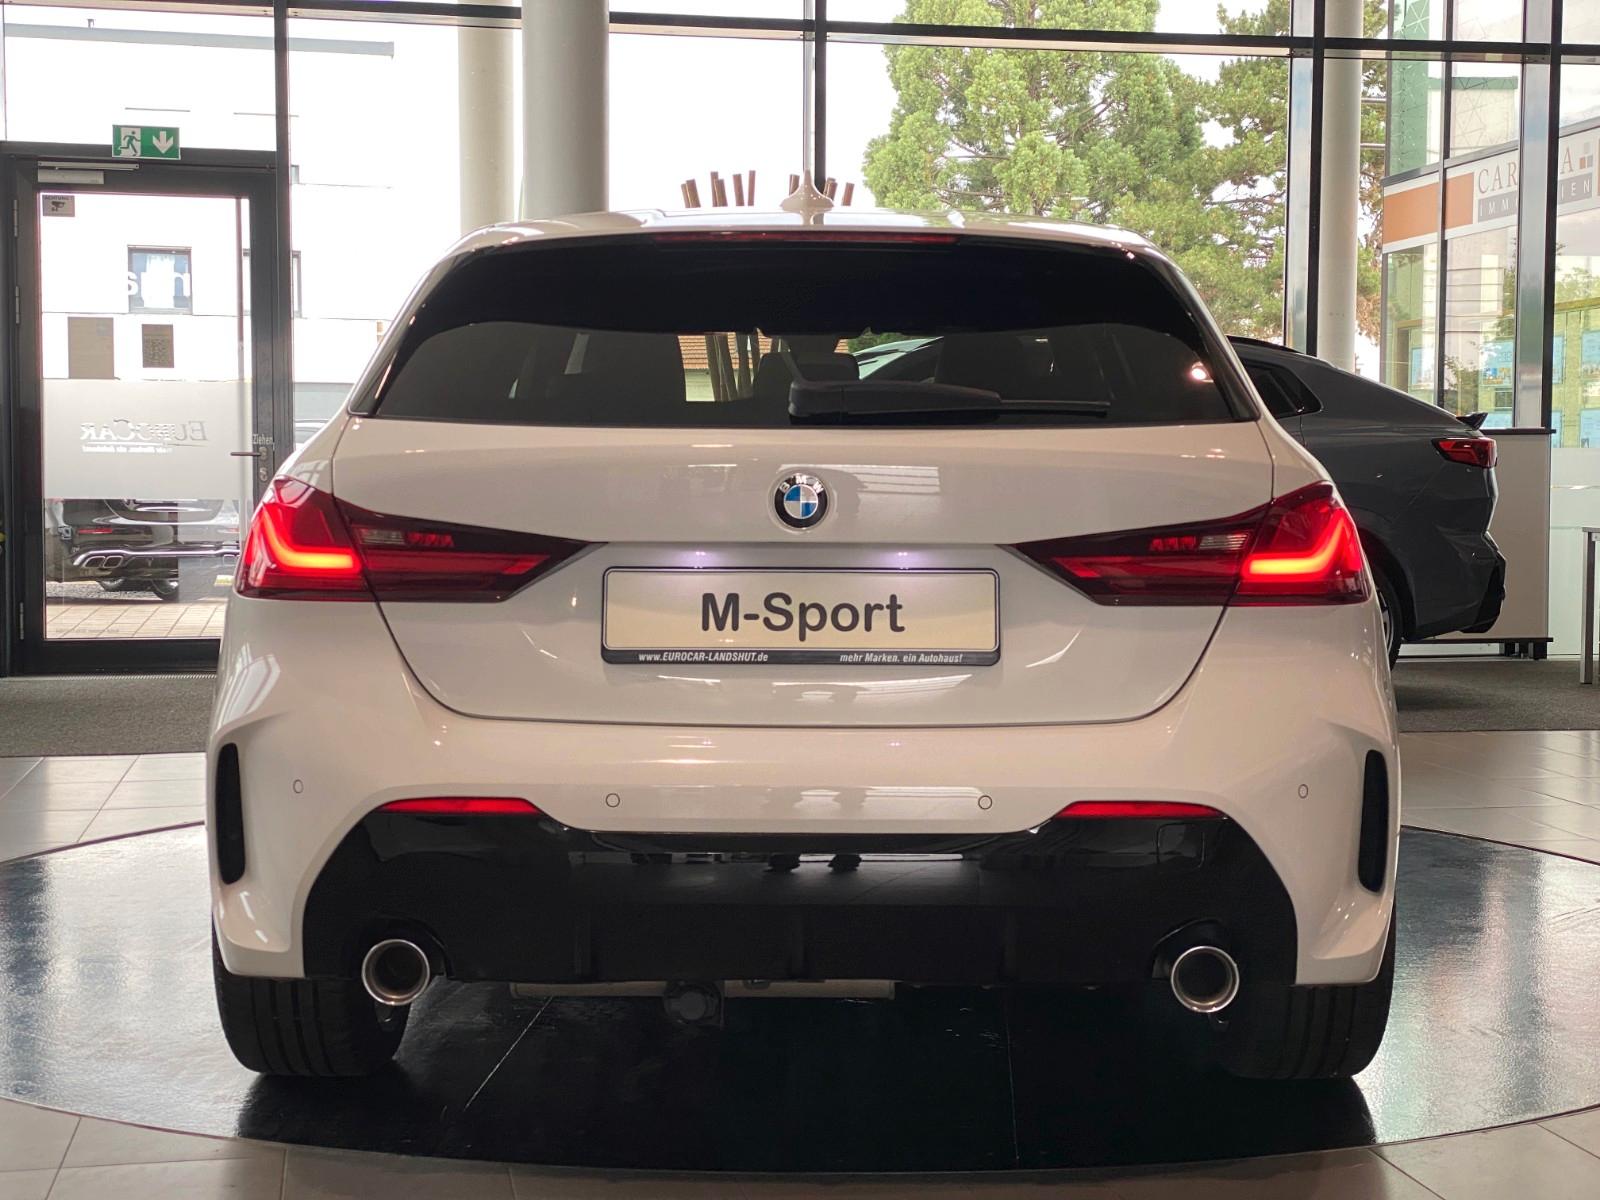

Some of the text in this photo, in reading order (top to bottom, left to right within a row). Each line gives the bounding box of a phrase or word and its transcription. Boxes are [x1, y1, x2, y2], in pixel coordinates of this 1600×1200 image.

[780, 473, 824, 493] BMW
[702, 592, 905, 642] M-Sport
[638, 651, 768, 662] www.EUROCAR-LANDSHUT.de
[840, 654, 862, 662] mehr
[903, 654, 917, 662] ein
[918, 653, 963, 663] Autohaus!
